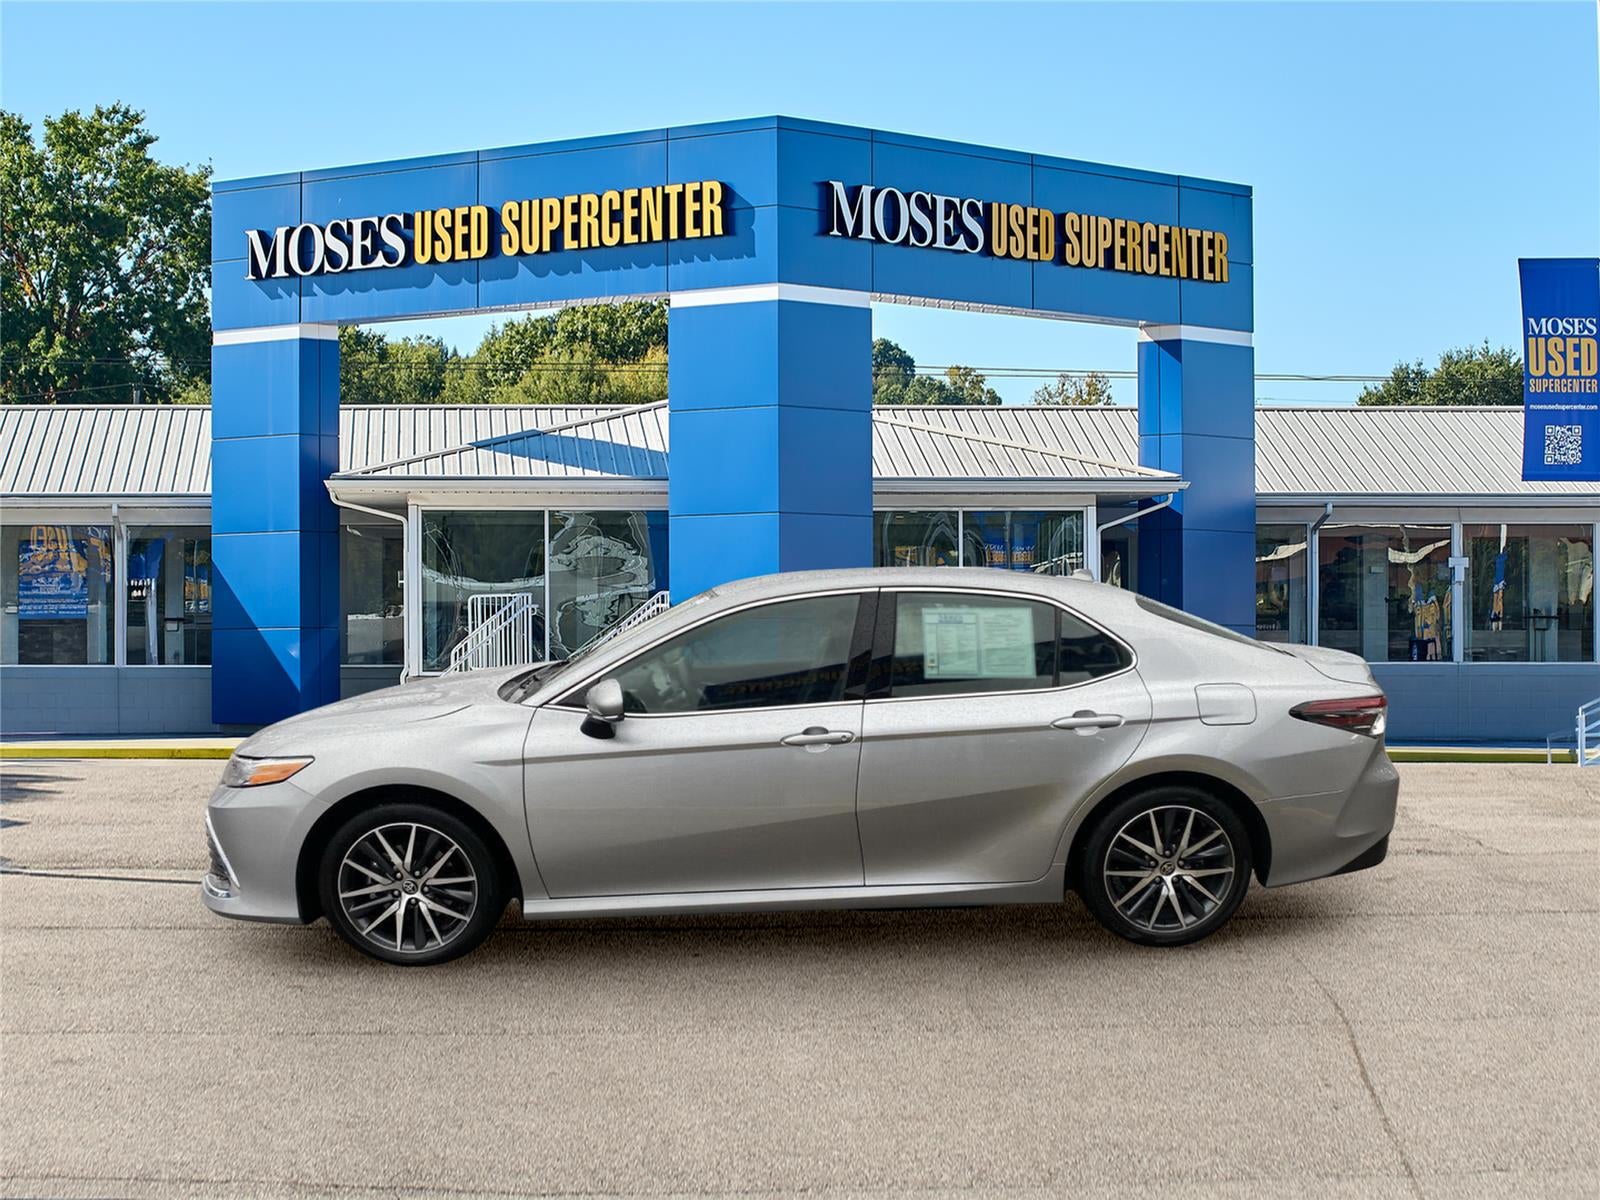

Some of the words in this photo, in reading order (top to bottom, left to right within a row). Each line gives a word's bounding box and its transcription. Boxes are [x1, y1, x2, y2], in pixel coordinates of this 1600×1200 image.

[244, 213, 407, 282] MOSES
[413, 205, 489, 266] USED
[500, 180, 724, 257] SUPERCENTER
[829, 180, 985, 254] MOSES
[991, 202, 1056, 263] USED
[1065, 211, 1230, 283] SUPERCENTER
[1527, 317, 1597, 336] MOSES
[1528, 336, 1598, 377] USED
[1529, 378, 1598, 393] SUPERCENTER
